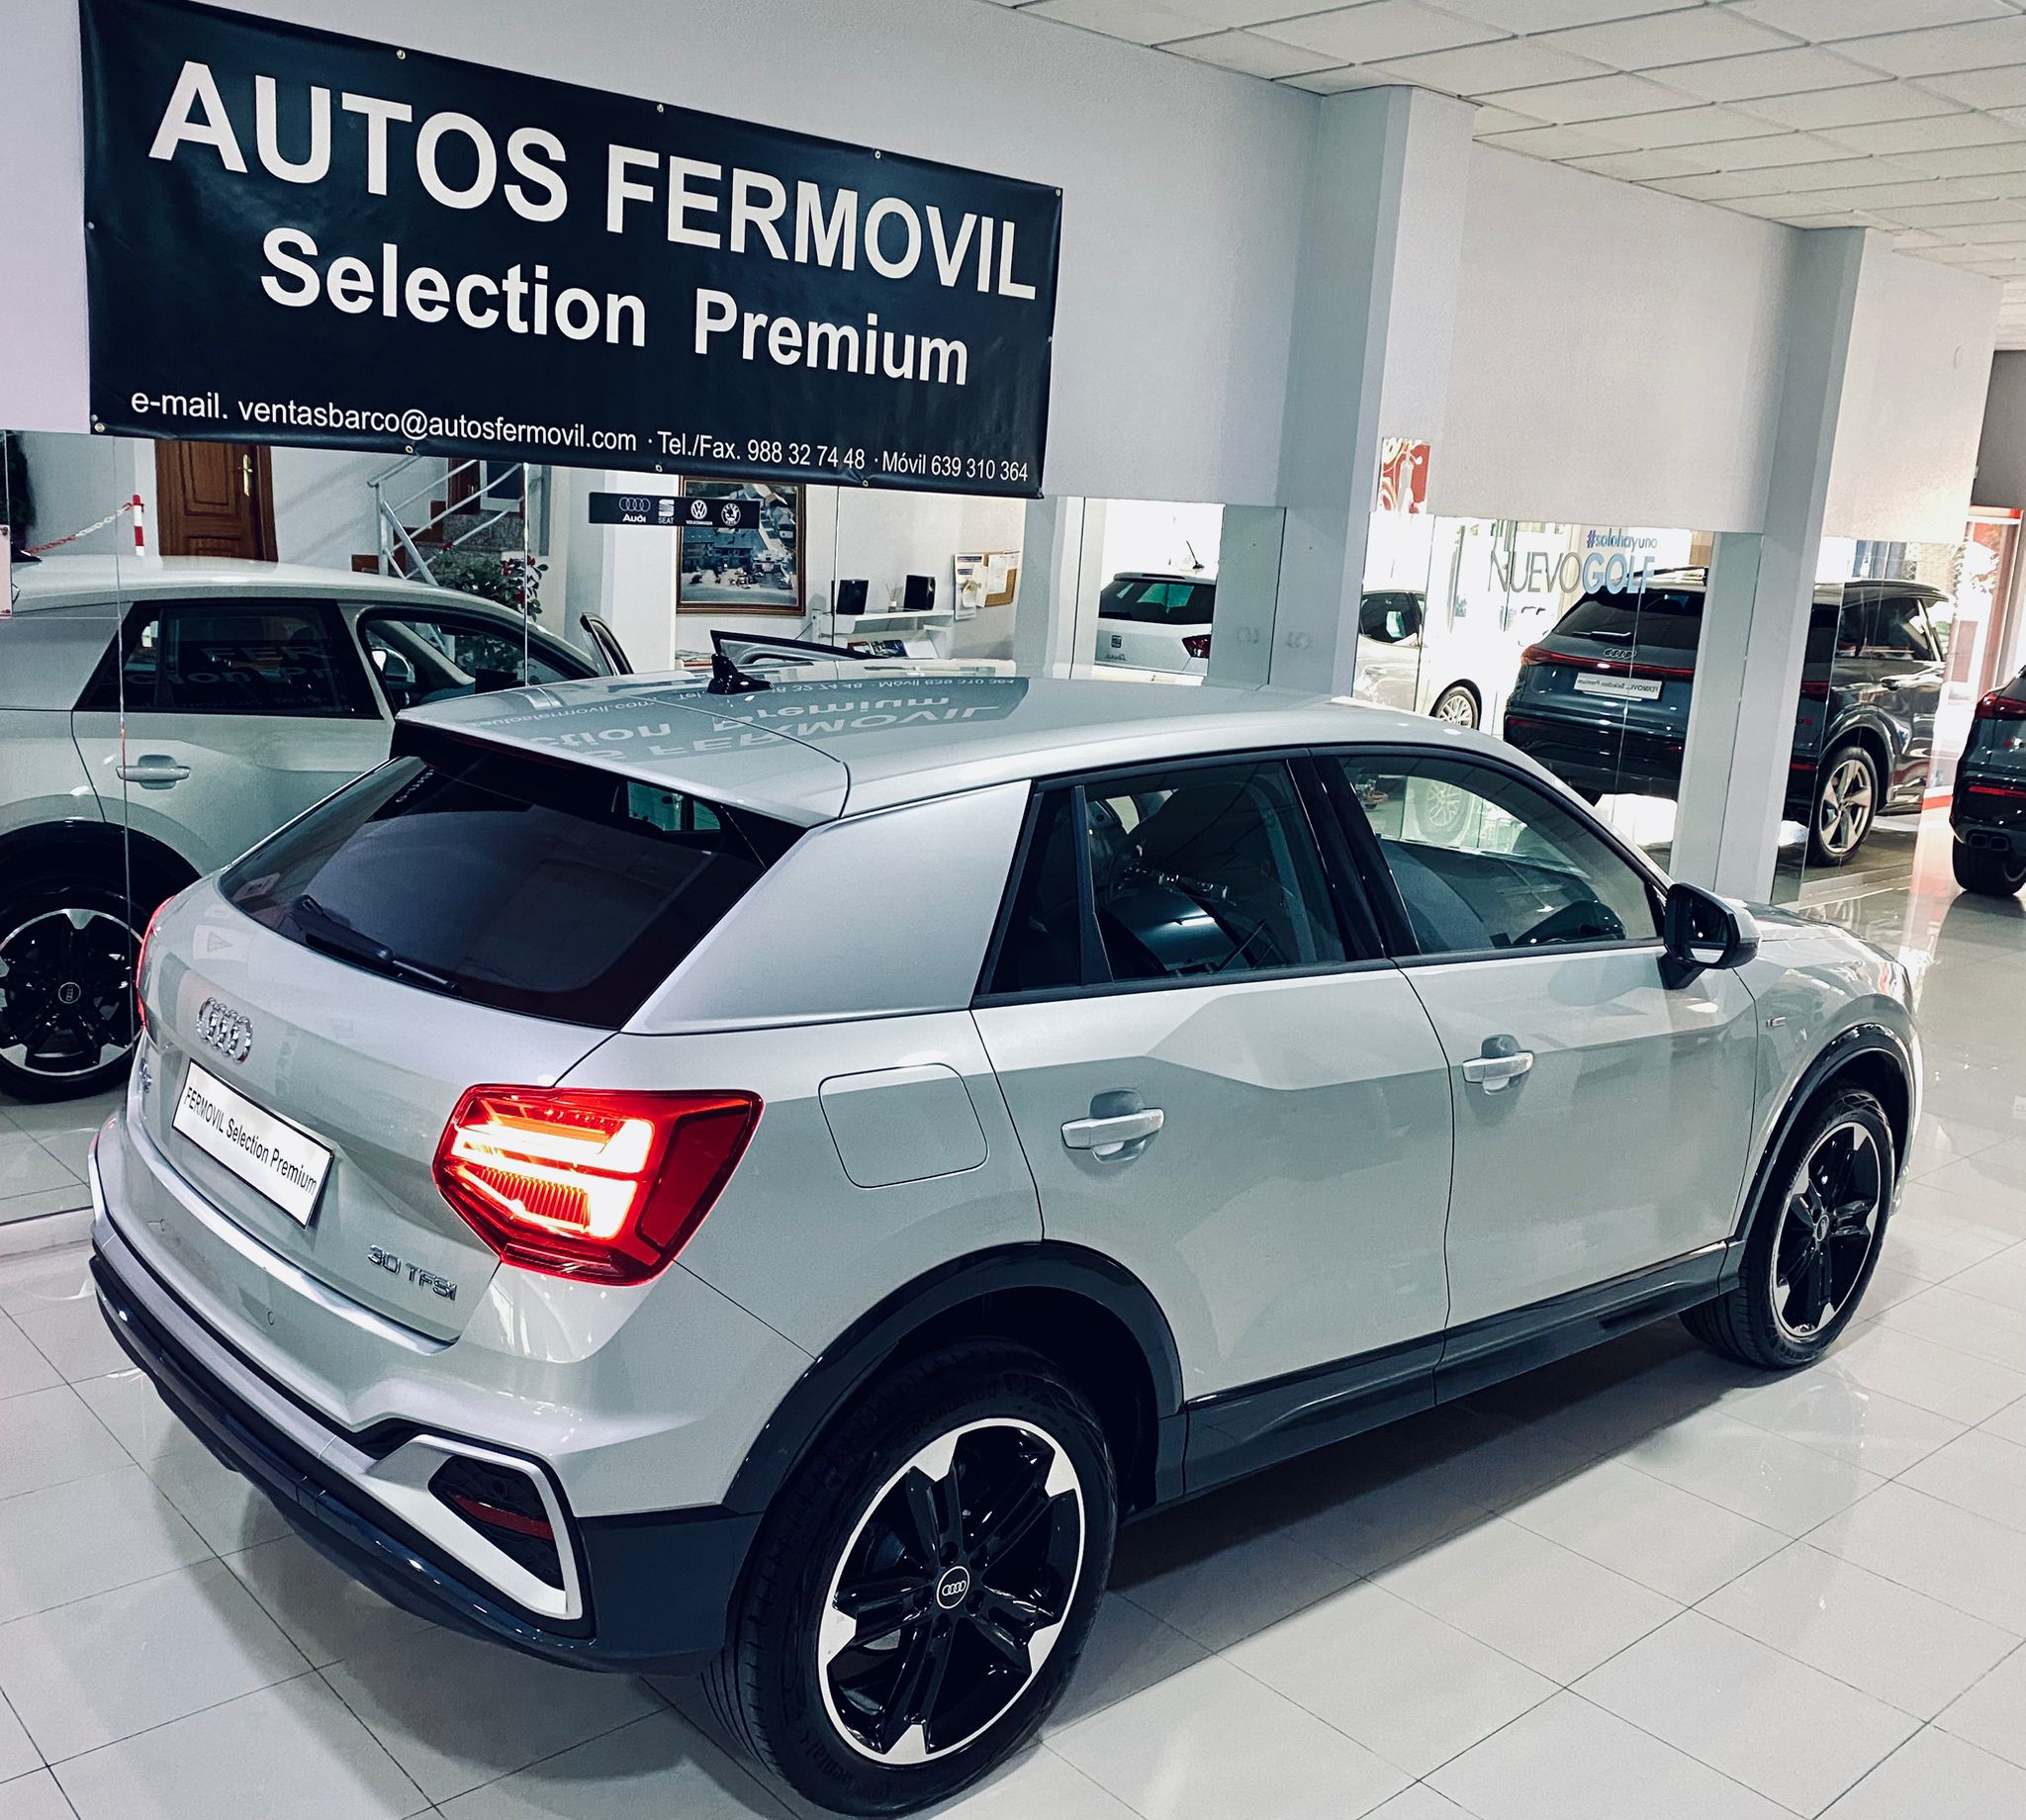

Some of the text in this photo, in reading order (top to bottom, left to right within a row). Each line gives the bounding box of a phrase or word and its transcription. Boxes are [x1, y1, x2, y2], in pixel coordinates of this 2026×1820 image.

[148, 60, 1037, 301] AUTOS FERMOVIL
[260, 227, 967, 386] Selection Premium
[131, 391, 1029, 482] e-mail. ventasbarco@autosfermovil.com Tel./Fax. 988 32 74 48 Móvil 639 310 364
[622, 513, 647, 523] Audi
[183, 1086, 318, 1196] FERMOVIL Selection Premium
[367, 1243, 458, 1302] 30 TFSI
